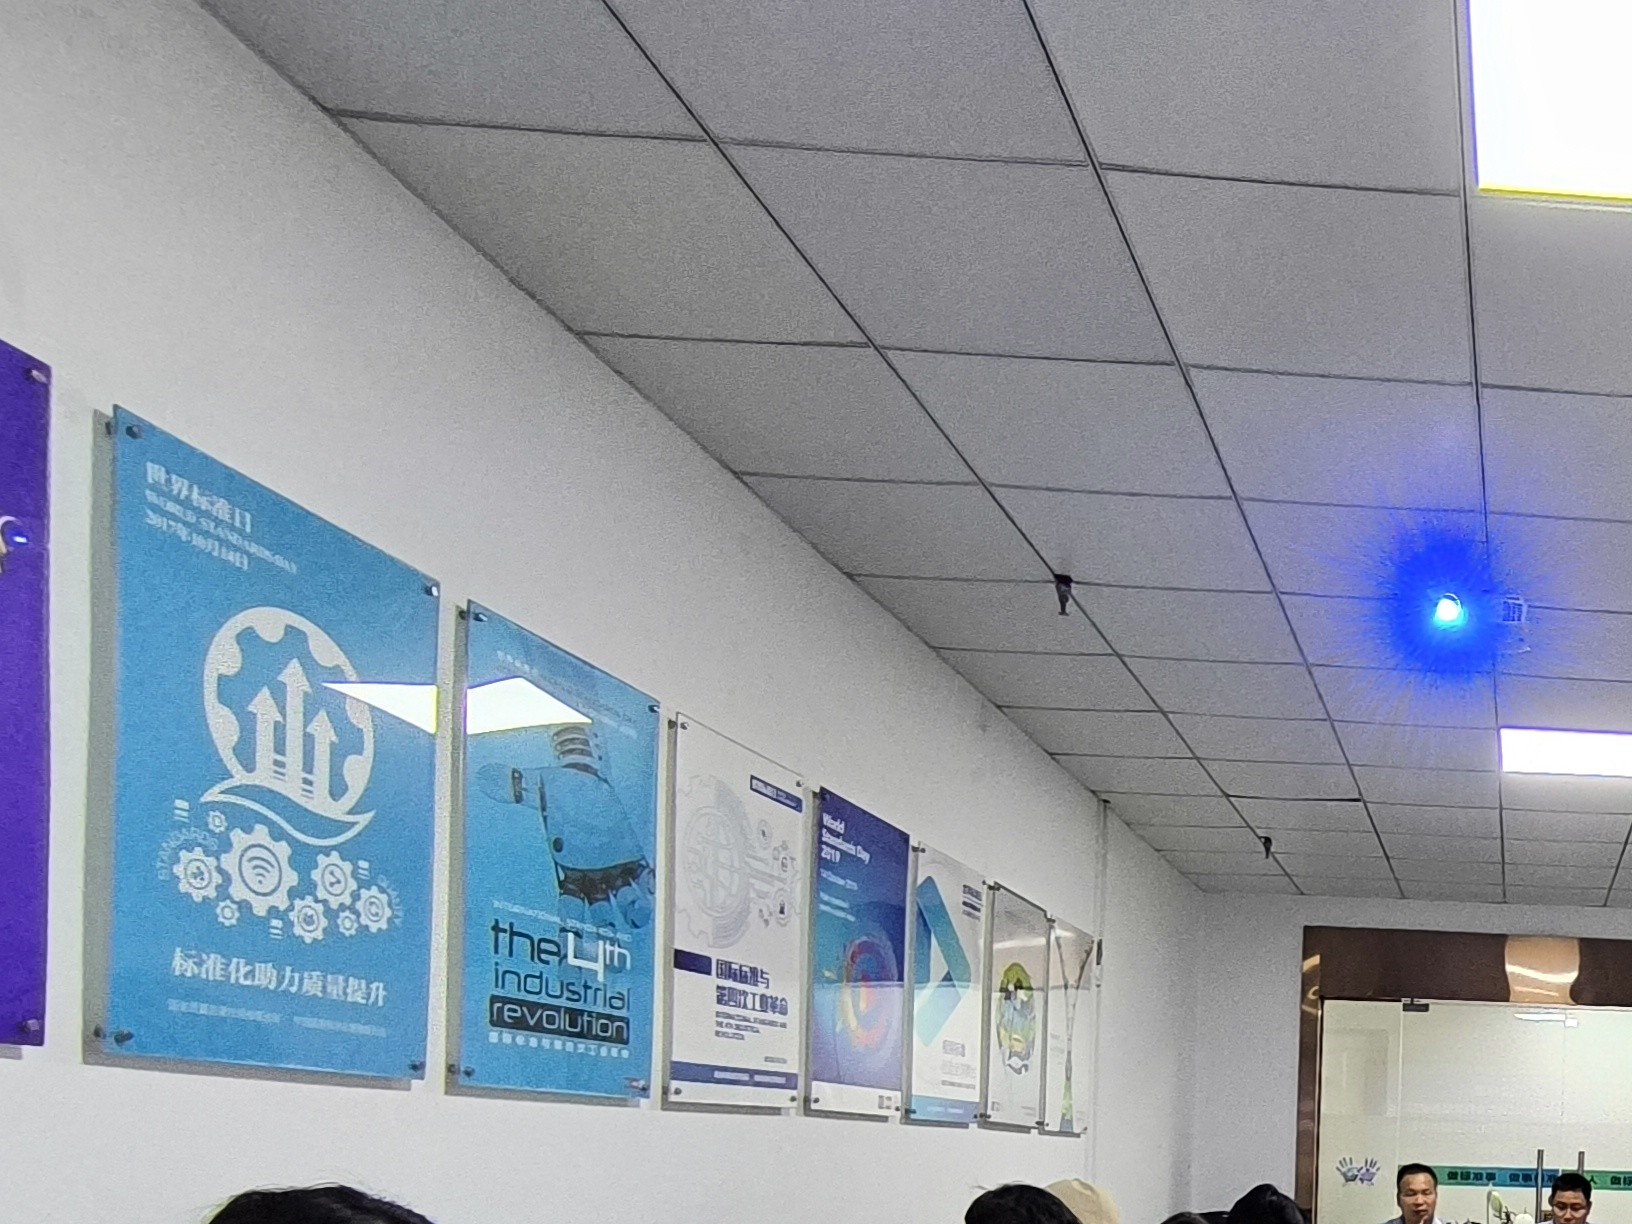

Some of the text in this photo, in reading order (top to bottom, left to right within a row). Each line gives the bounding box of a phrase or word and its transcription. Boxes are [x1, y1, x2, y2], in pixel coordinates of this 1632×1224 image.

[146, 461, 252, 533] 世界标准日
[490, 918, 562, 967] the
[171, 947, 388, 1008] 标准化助力质量提升
[492, 961, 631, 1012] industrial
[493, 1002, 628, 1040] revolution
